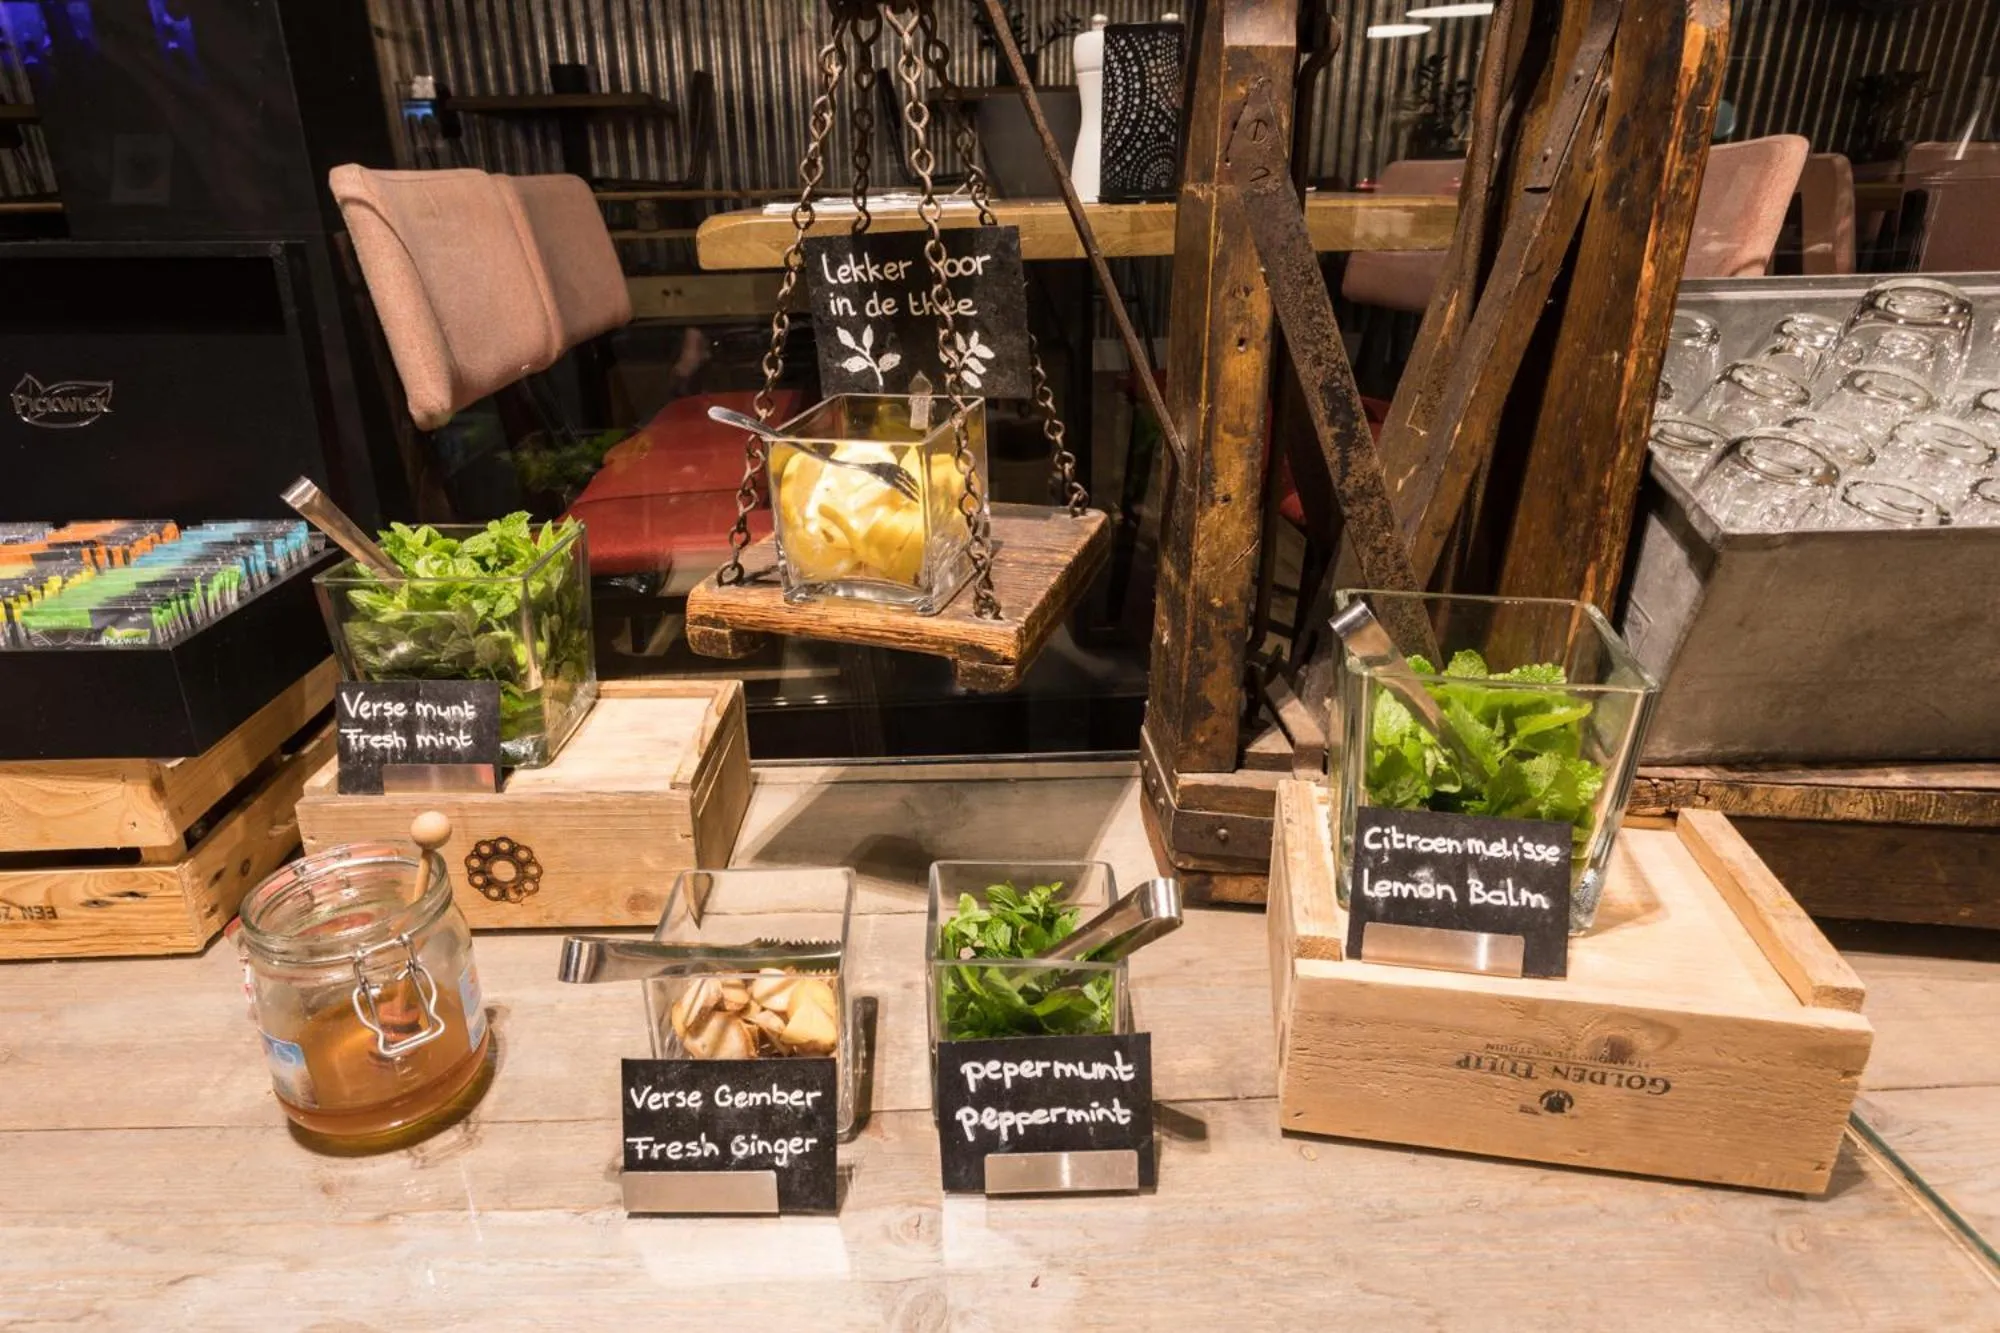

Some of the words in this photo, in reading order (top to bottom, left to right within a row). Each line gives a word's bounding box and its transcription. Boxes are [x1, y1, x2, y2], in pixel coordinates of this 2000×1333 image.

[928, 254, 992, 279] oor
[829, 293, 856, 317] in
[865, 291, 899, 317] de
[908, 292, 978, 317] thee
[341, 691, 408, 719] Verse
[415, 701, 476, 719] munt
[340, 728, 407, 750] Fresh
[415, 729, 473, 749] mint
[1363, 868, 1457, 902] Lemon
[1467, 877, 1550, 909] Balm
[960, 1050, 1135, 1092] pepermunt
[1553, 1065, 1672, 1095] GOLDEN
[630, 1085, 702, 1110] Verse
[714, 1083, 822, 1108] Gember
[955, 1098, 1131, 1142] peppermint
[626, 1132, 719, 1160] Fresh
[730, 1134, 818, 1167] Ginger
